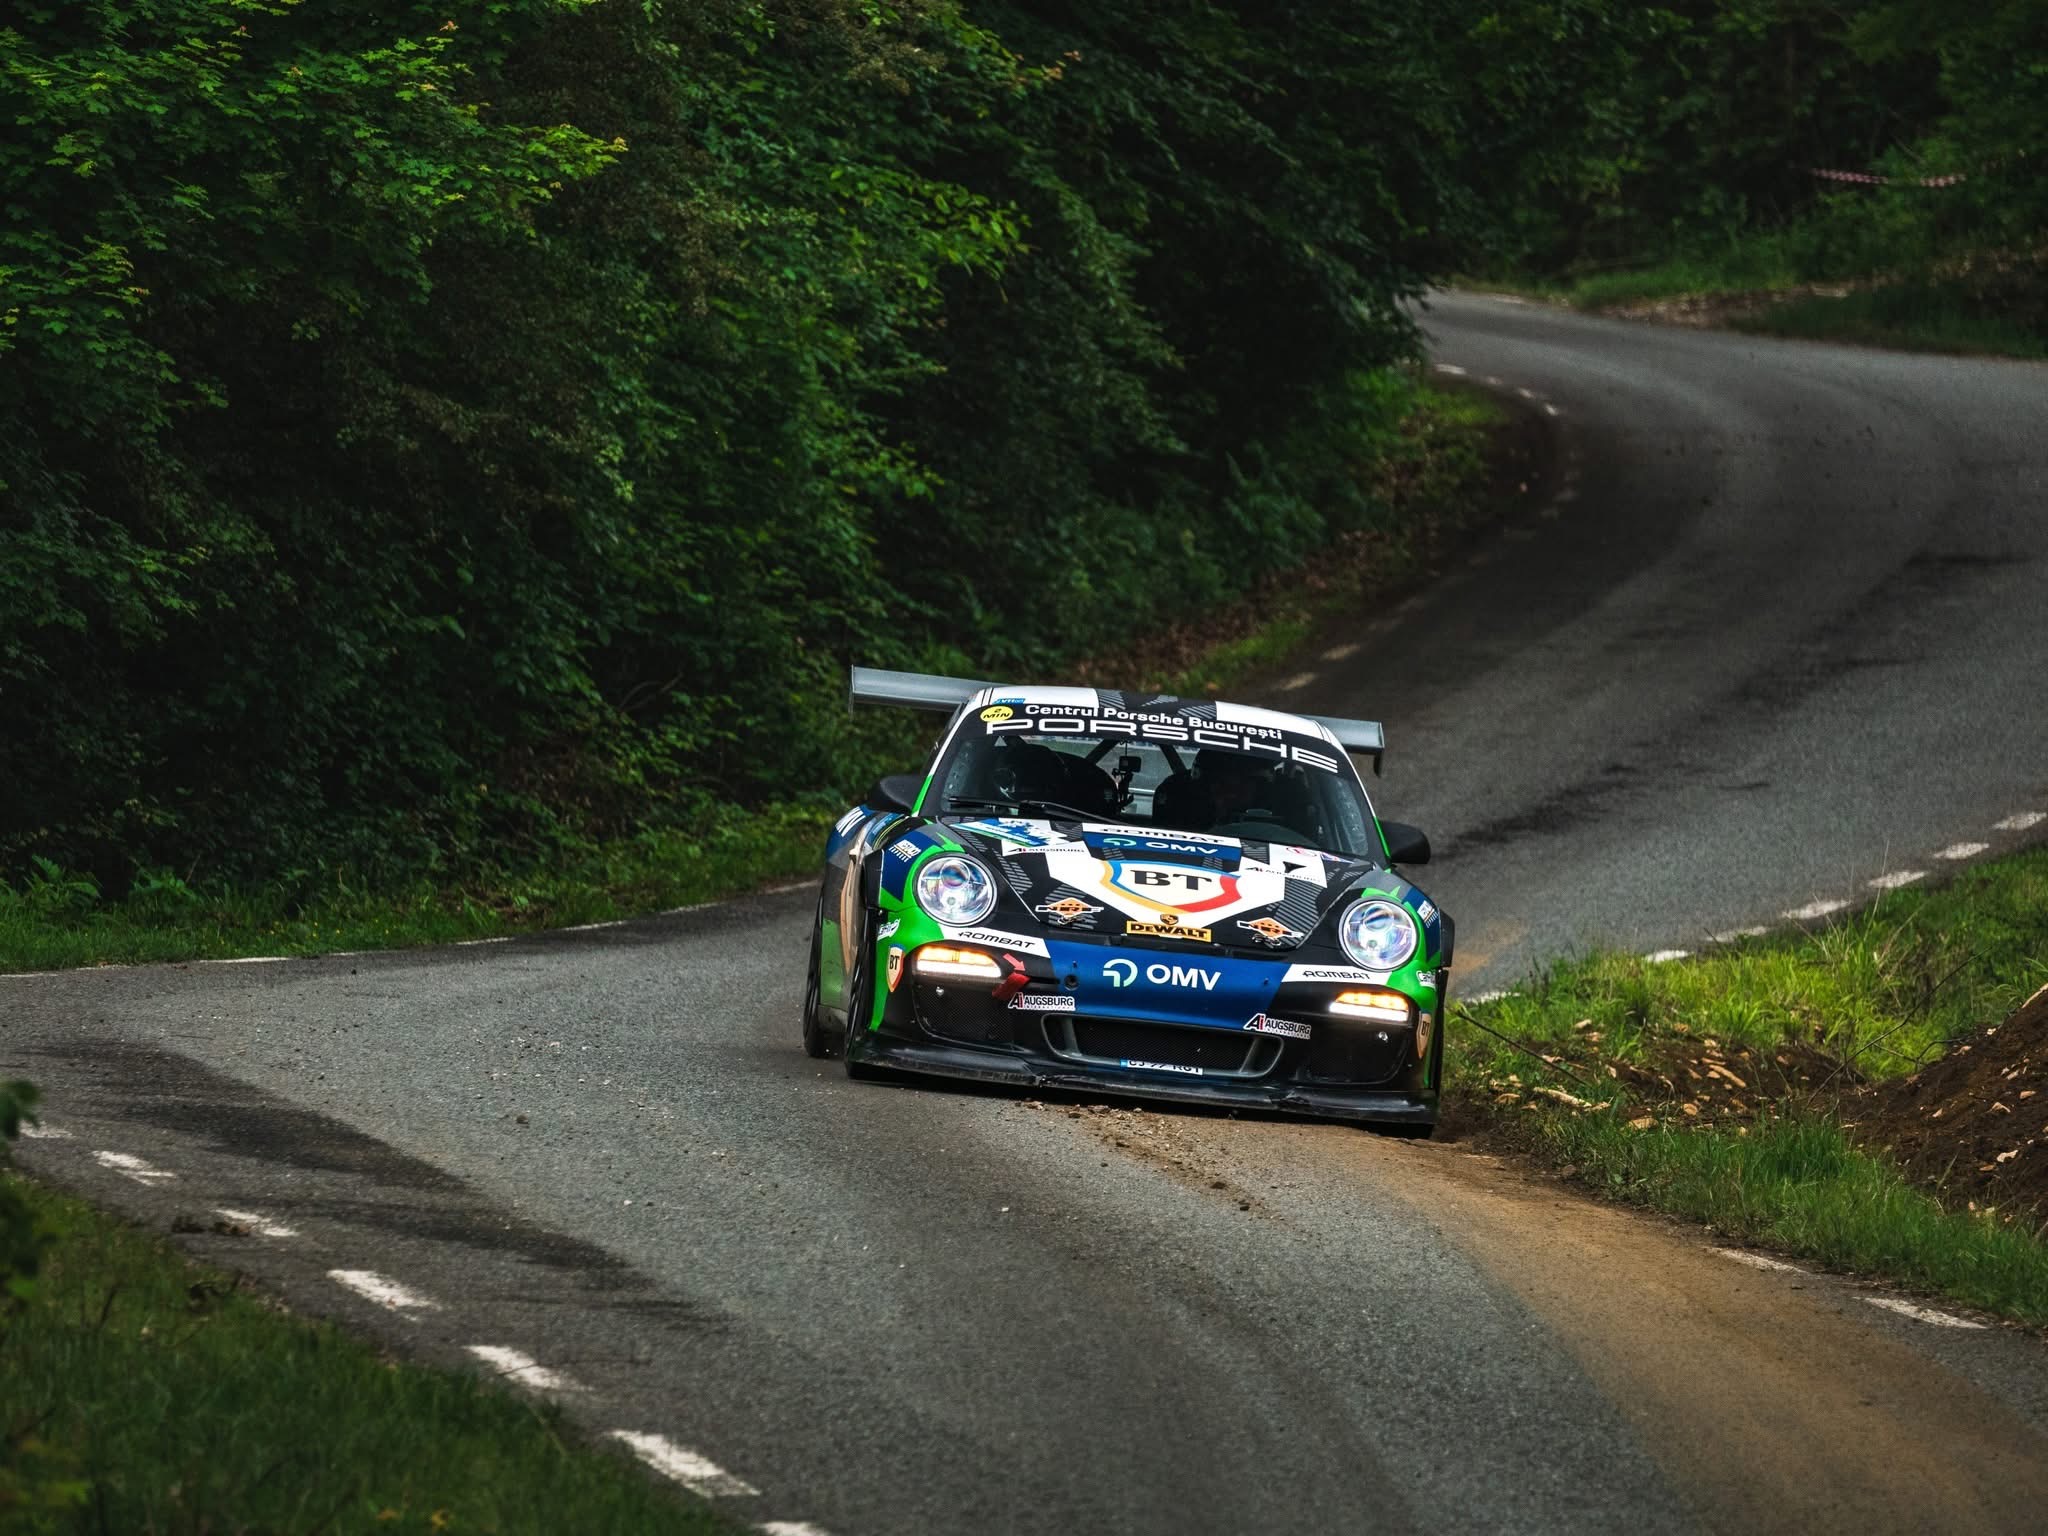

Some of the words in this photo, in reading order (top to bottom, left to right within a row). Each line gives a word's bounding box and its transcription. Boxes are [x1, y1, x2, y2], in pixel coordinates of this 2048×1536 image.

[1025, 705, 1098, 717] Centrul
[1103, 707, 1184, 726] Porsche
[986, 718, 1338, 774] PORSCHE
[1145, 841, 1219, 854] OMV
[1130, 869, 1212, 891] BT
[958, 931, 1035, 948] ROMBAT
[889, 954, 900, 970] BT
[1146, 963, 1221, 990] OMV
[1302, 970, 1371, 980] ROMBAT
[1024, 996, 1074, 1006] AUGSBURG
[1265, 1018, 1311, 1035] AUGSBURG
